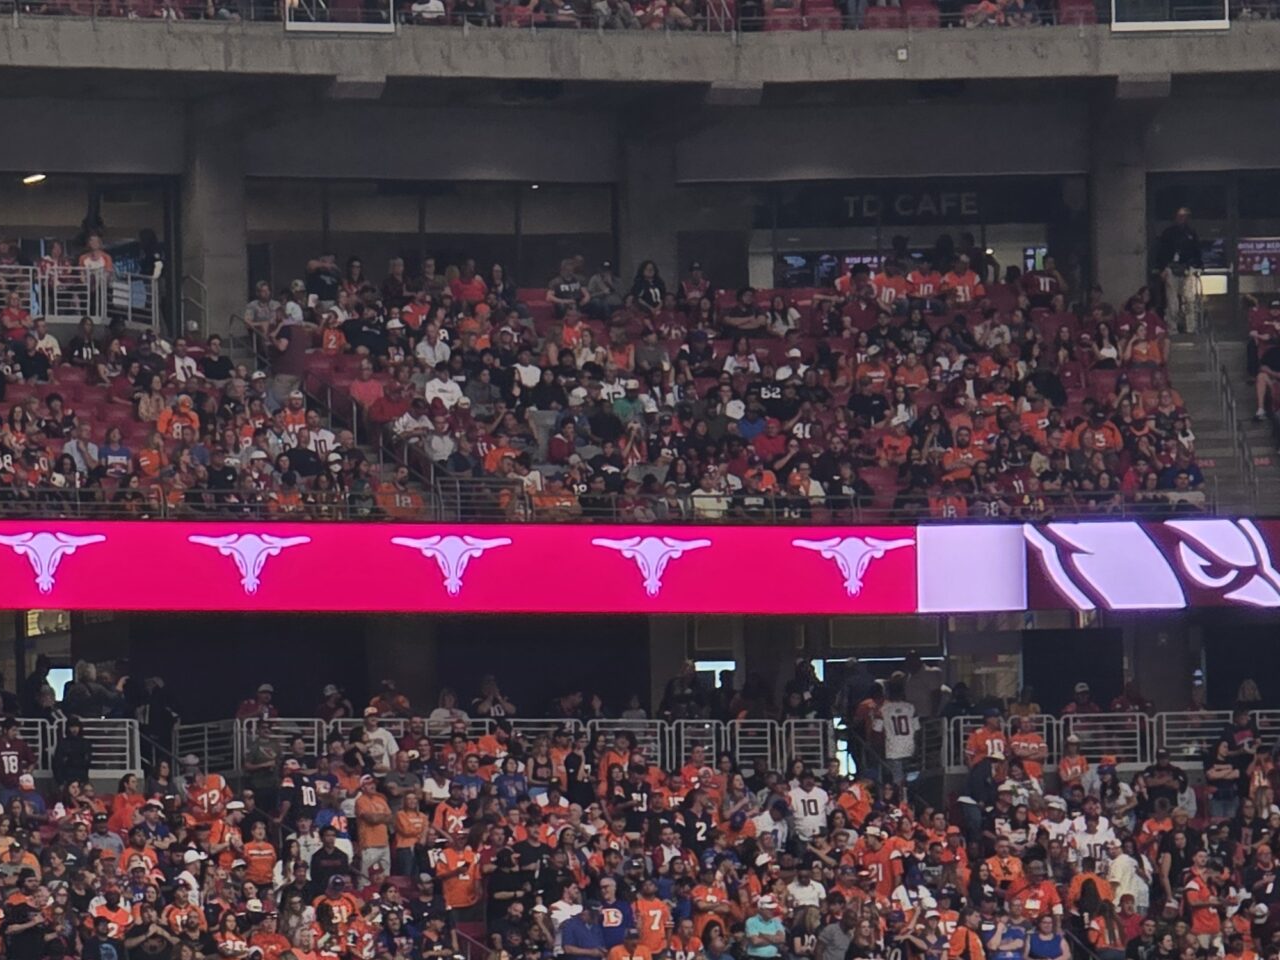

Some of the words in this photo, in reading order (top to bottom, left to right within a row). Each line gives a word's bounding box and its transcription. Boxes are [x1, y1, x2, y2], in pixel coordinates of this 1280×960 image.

[894, 193, 980, 216] CAFE
[328, 336, 336, 348] 2
[892, 717, 909, 735] 10
[985, 740, 1004, 758] 10
[2, 756, 18, 773] 18
[302, 787, 316, 806] 10
[800, 800, 818, 815] 10
[697, 823, 706, 841] 2
[649, 910, 661, 930] 7
